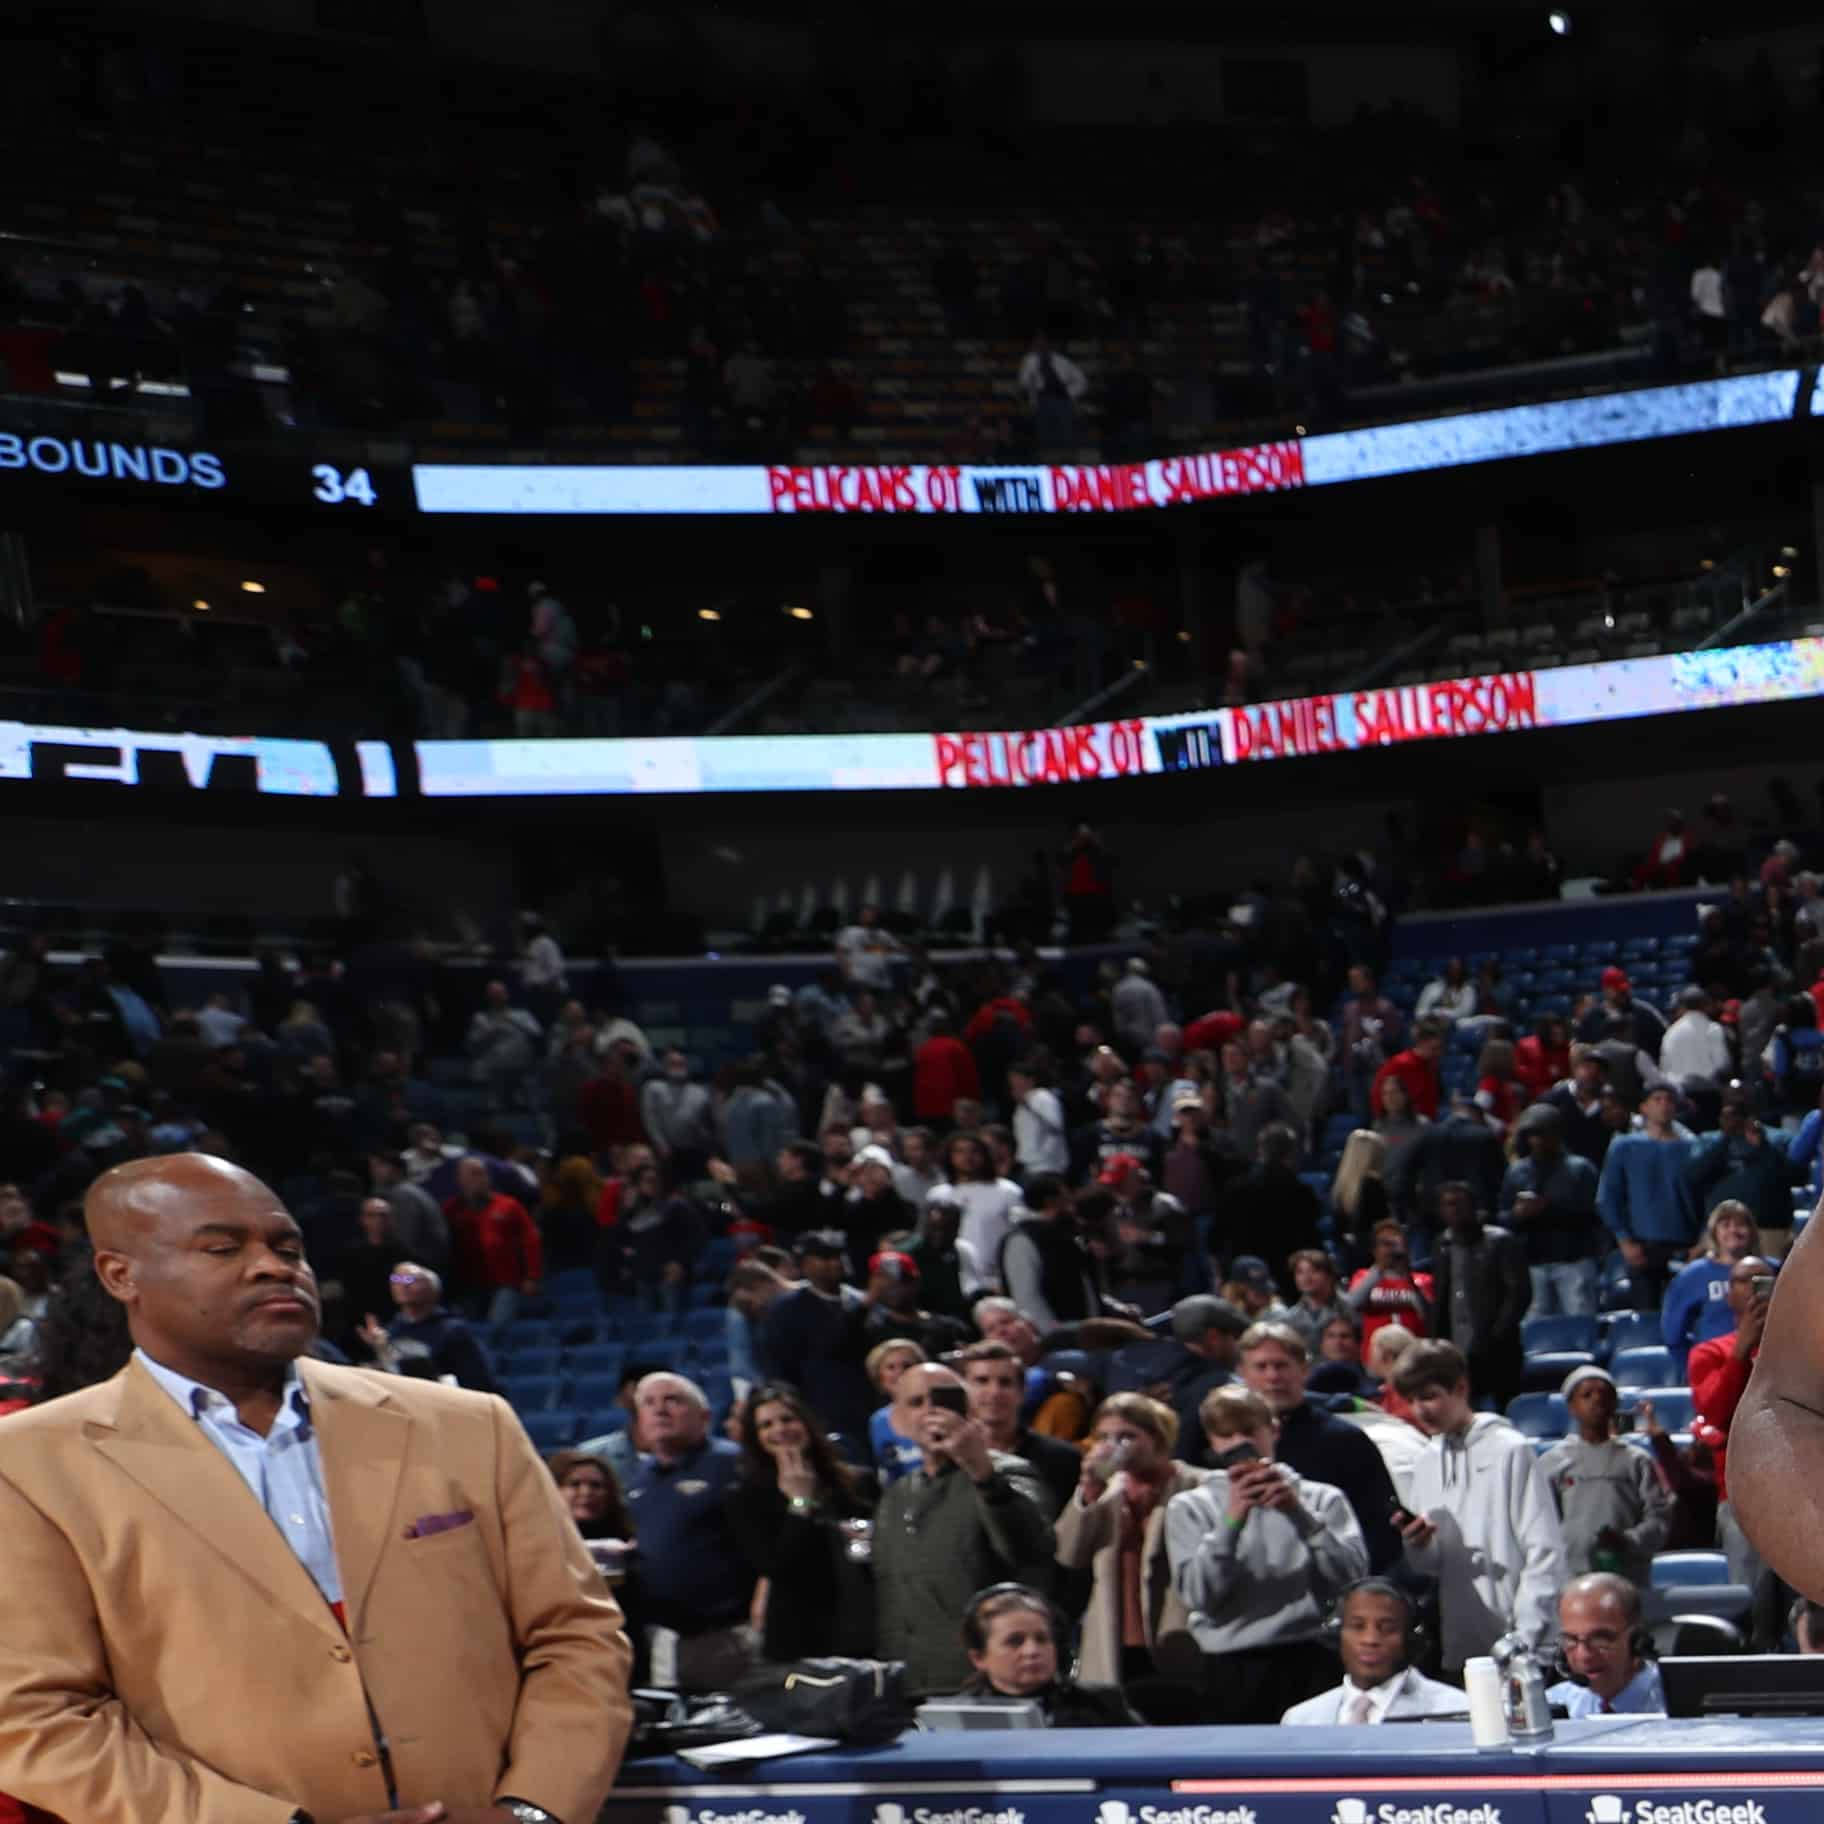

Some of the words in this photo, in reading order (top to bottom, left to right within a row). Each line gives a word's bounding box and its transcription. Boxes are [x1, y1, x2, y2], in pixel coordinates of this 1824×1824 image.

[311, 464, 378, 506] 34
[770, 465, 917, 513] PELICANS
[926, 466, 962, 511] OT
[1050, 461, 1149, 513] DANIEL
[1161, 439, 1303, 502] SALLERSON
[934, 725, 1100, 787] PELICANS
[1111, 719, 1147, 774] OT
[1230, 695, 1348, 760] DANIEL
[1354, 670, 1537, 748] SALLERSON
